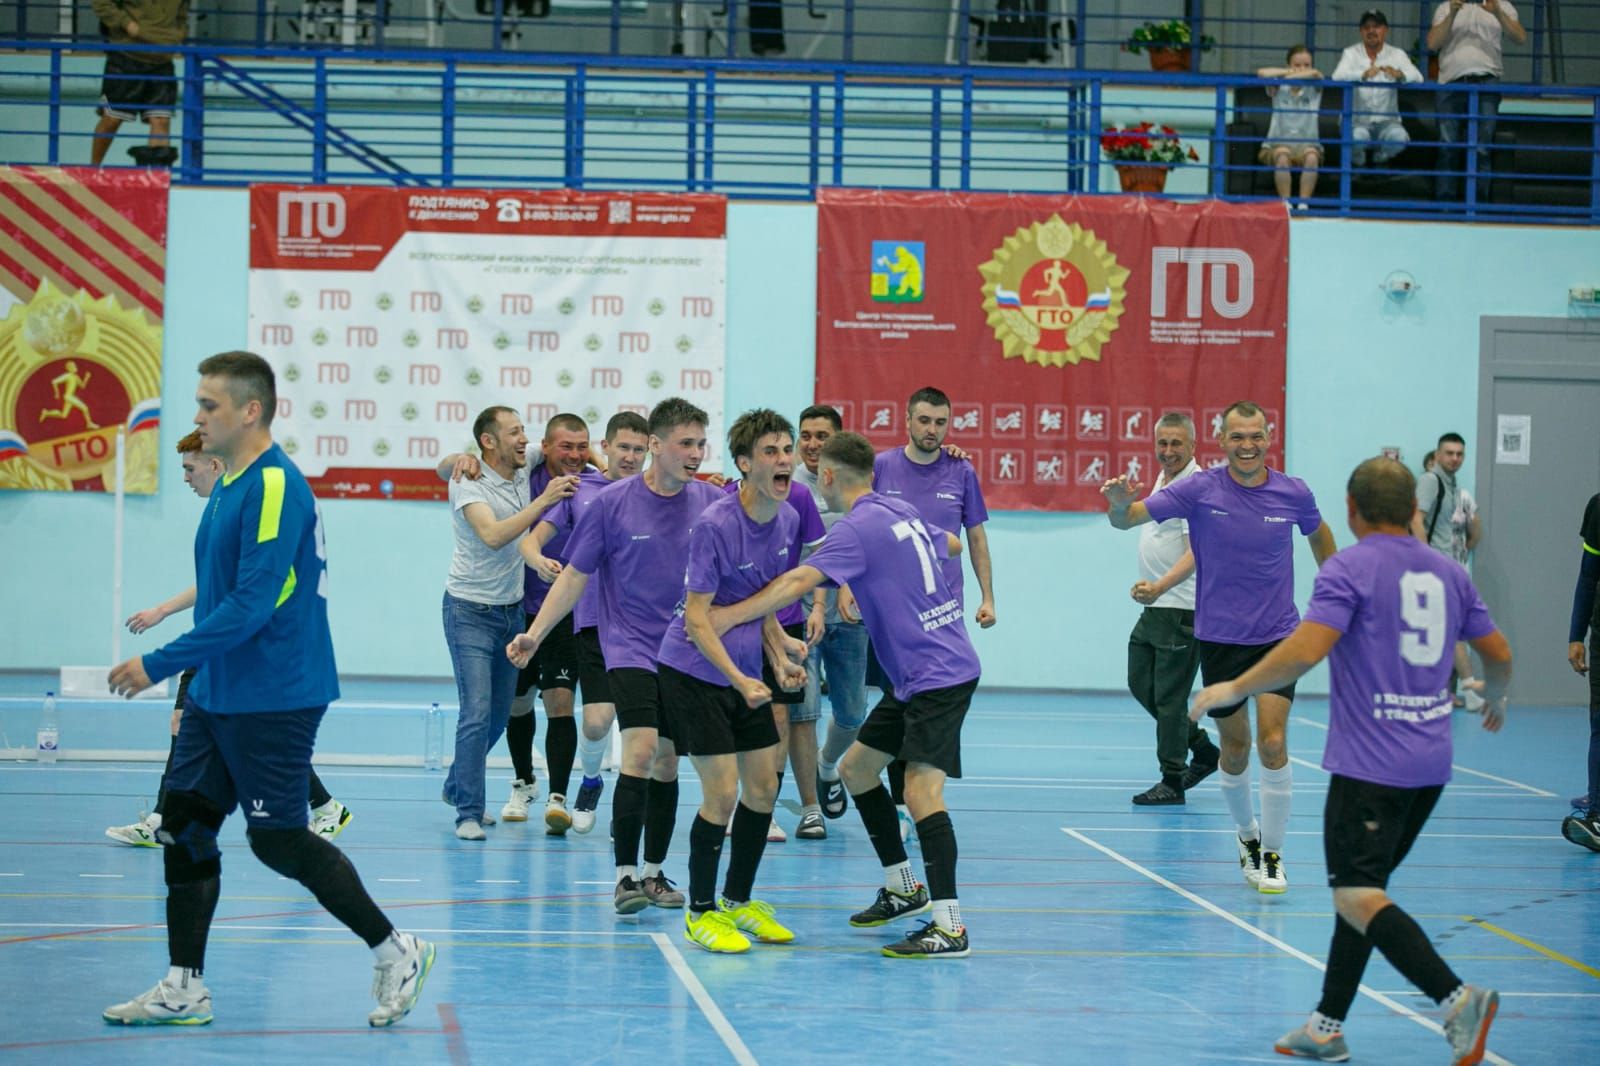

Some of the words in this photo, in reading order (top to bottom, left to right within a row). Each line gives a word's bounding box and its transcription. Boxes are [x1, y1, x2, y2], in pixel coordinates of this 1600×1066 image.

[408, 195, 490, 209] ПОДТЯНИСЬ
[278, 191, 347, 238] ГТО
[1150, 246, 1255, 319] ГТО
[319, 289, 352, 310] ГТО
[410, 291, 442, 312] ГТО
[501, 293, 533, 315] ГТО
[592, 295, 624, 316] ГТО
[682, 296, 713, 317] ГТО
[1037, 309, 1073, 324] ГТО
[262, 324, 293, 345] ГТО
[346, 326, 378, 347] ГТО
[437, 328, 468, 349] ГТО
[528, 331, 560, 352] ГТО
[619, 332, 650, 352] ГТО
[318, 362, 349, 383] ГТО
[408, 364, 440, 385] ГТО
[500, 366, 531, 387] ГТО
[591, 368, 622, 388] ГТО
[681, 369, 712, 390] ГТО
[345, 399, 376, 420] ГТО
[435, 400, 467, 421] ГТО
[53, 434, 108, 467] ГТО
[317, 436, 348, 456] ГТО
[408, 437, 440, 458] ГТО
[1399, 570, 1447, 666] 9
